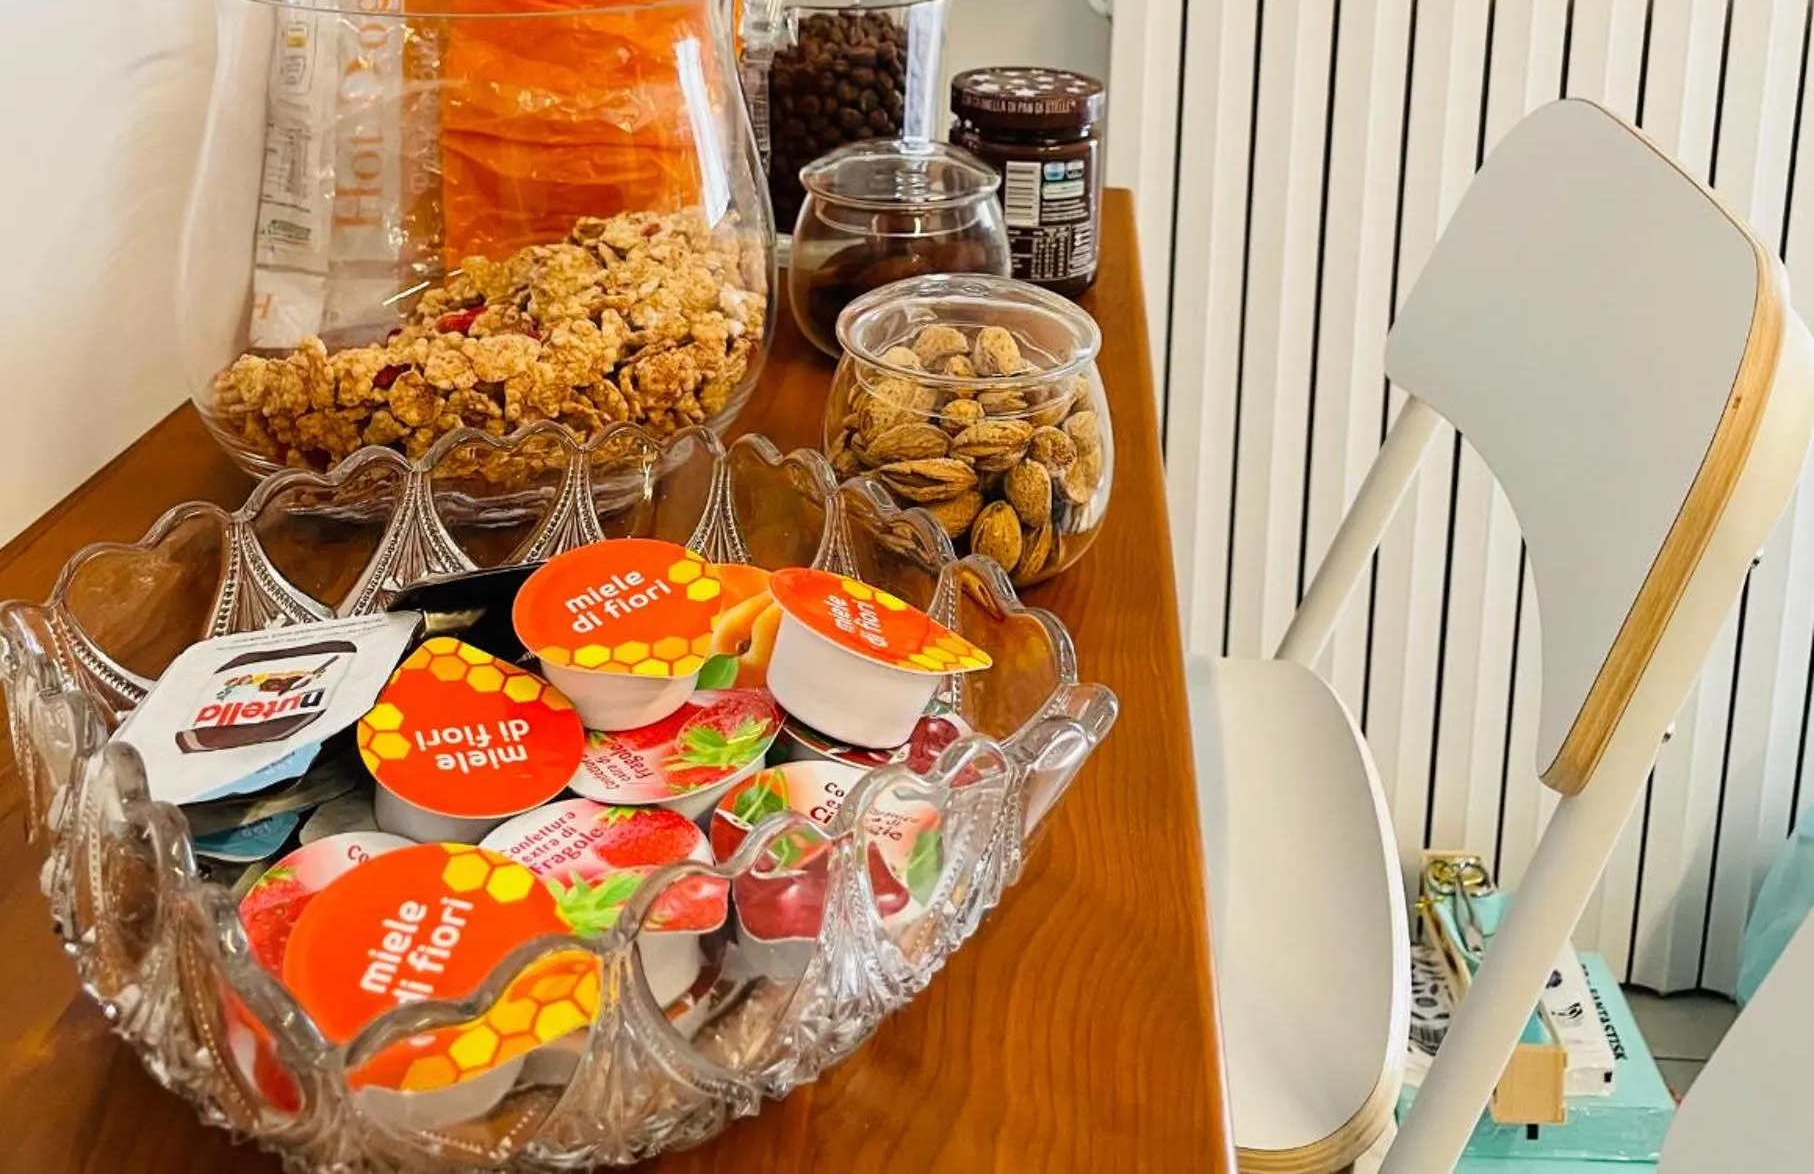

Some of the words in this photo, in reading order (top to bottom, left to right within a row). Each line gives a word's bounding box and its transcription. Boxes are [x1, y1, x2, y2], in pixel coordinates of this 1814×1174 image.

[331, 133, 384, 229] Hot
[564, 570, 646, 614] miele
[572, 611, 604, 634] di
[603, 579, 672, 619] fiori
[823, 594, 857, 634] miele
[194, 688, 326, 727] nutella
[414, 723, 493, 752] fiori
[497, 719, 531, 743] di
[434, 744, 529, 775] miele
[521, 838, 560, 863] extra
[560, 826, 578, 839] di
[359, 899, 428, 994] miele
[406, 896, 475, 975] fiori
